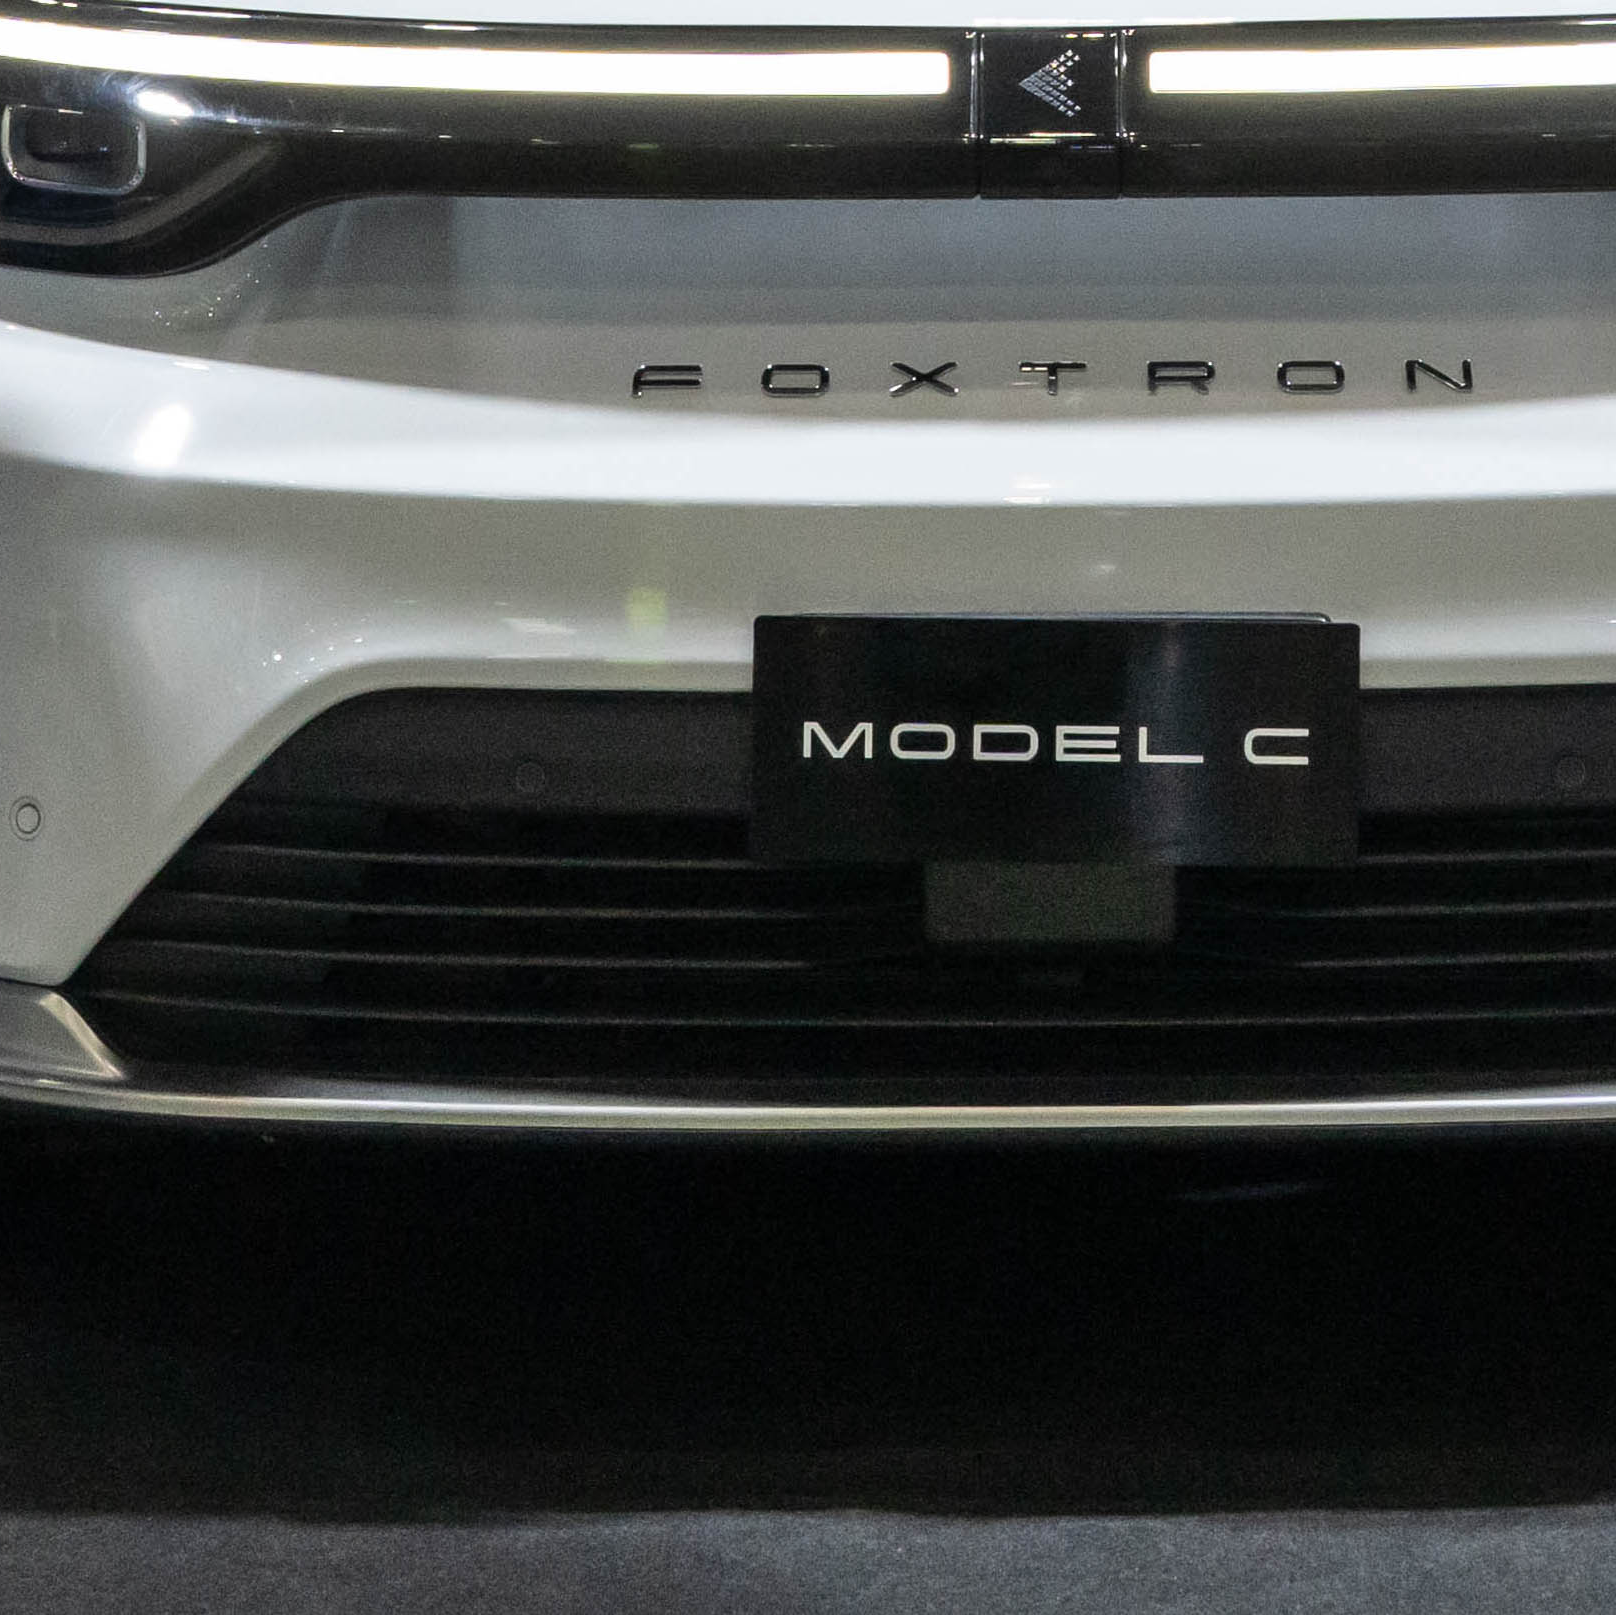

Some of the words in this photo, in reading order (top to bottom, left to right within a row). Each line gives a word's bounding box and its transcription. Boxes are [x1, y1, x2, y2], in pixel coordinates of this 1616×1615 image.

[631, 358, 1474, 398] FOXTRON
[801, 721, 1204, 764] MODEL
[1244, 727, 1310, 766] C
